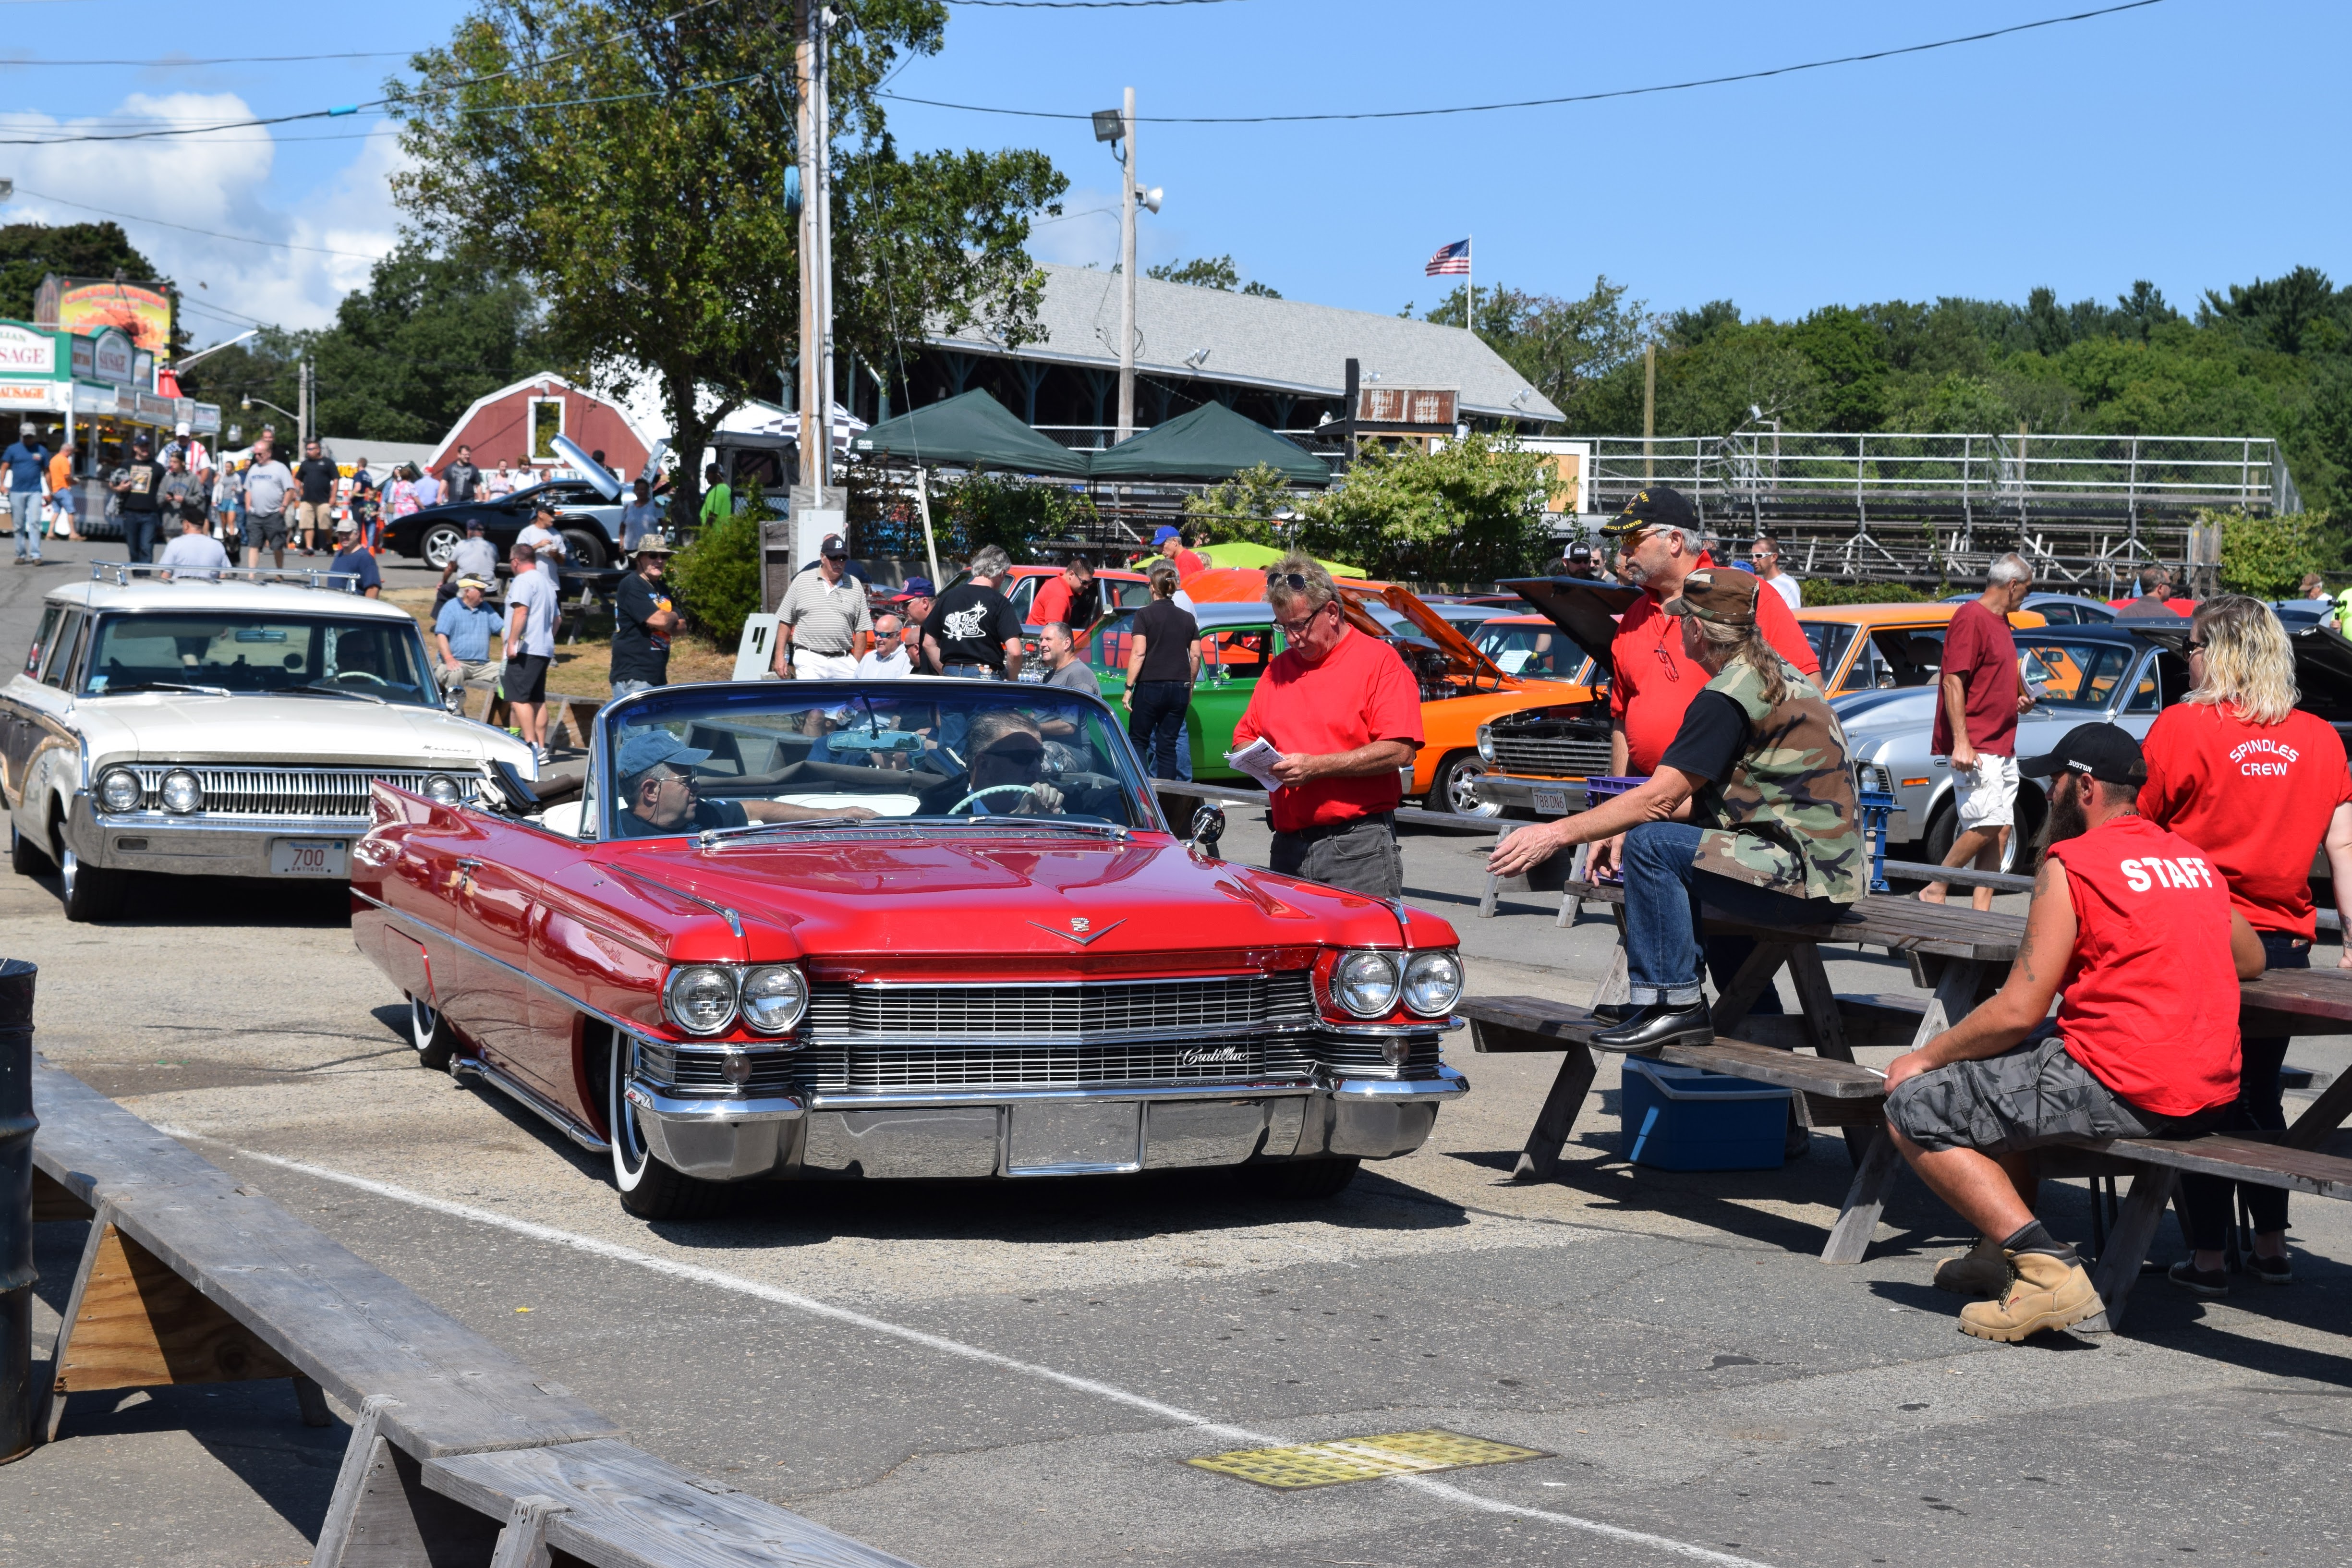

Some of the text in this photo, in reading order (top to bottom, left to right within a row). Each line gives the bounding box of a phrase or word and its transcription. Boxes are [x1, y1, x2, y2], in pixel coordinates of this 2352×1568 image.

[1638, 491, 1649, 503] RMY
[1623, 519, 1643, 530] SERVED
[835, 540, 843, 548] B
[2229, 739, 2300, 764] SPINDLES
[2067, 759, 2093, 773] BOSTON
[2241, 762, 2288, 776] CREW
[1534, 794, 1564, 809] 788 DN6
[293, 849, 325, 866] 700
[2120, 857, 2213, 892] STAFF
[1178, 1045, 1250, 1067] Cadillac
